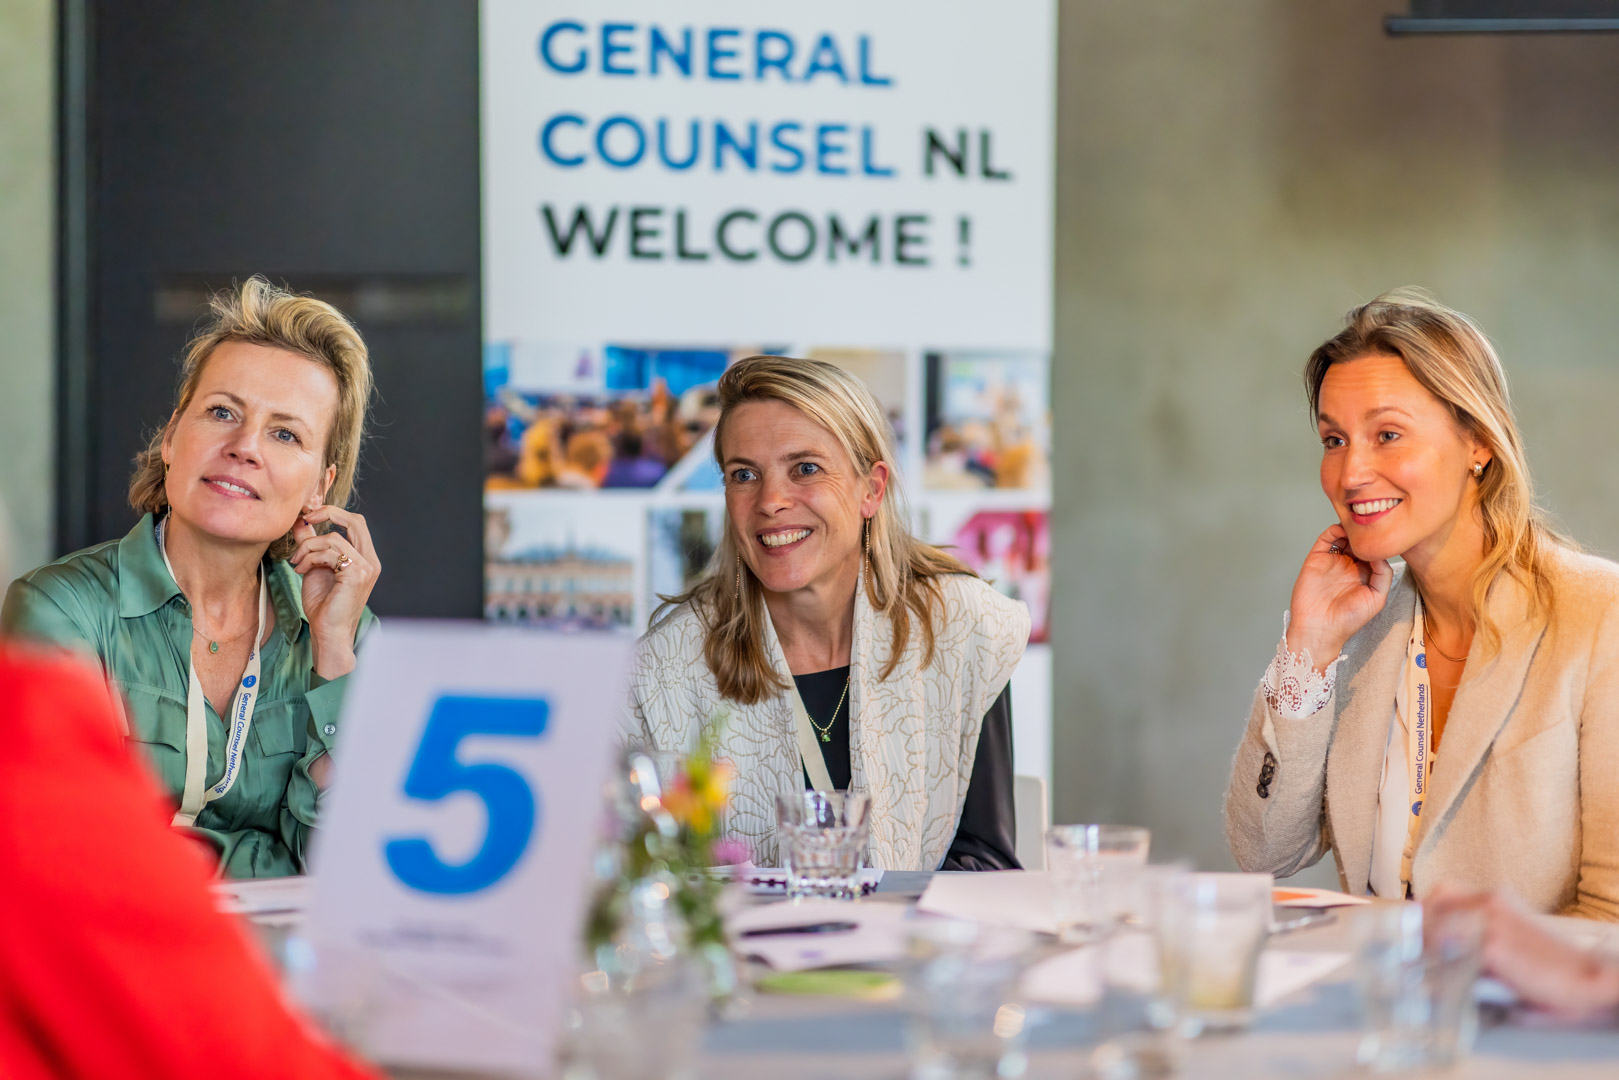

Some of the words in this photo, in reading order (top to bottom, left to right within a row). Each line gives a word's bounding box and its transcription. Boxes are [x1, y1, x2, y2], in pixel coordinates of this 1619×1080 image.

[537, 20, 894, 87] GENERAL
[538, 113, 895, 177] COUNSEL
[923, 128, 1011, 181] NL
[541, 204, 929, 266] WELCOME
[239, 692, 252, 721] General
[1416, 683, 1425, 729] Netherlands
[231, 721, 245, 752] Counsel
[1416, 730, 1425, 762] Counsel
[214, 751, 238, 794] Netherlands
[1415, 763, 1424, 795] General
[383, 693, 551, 897] 5
